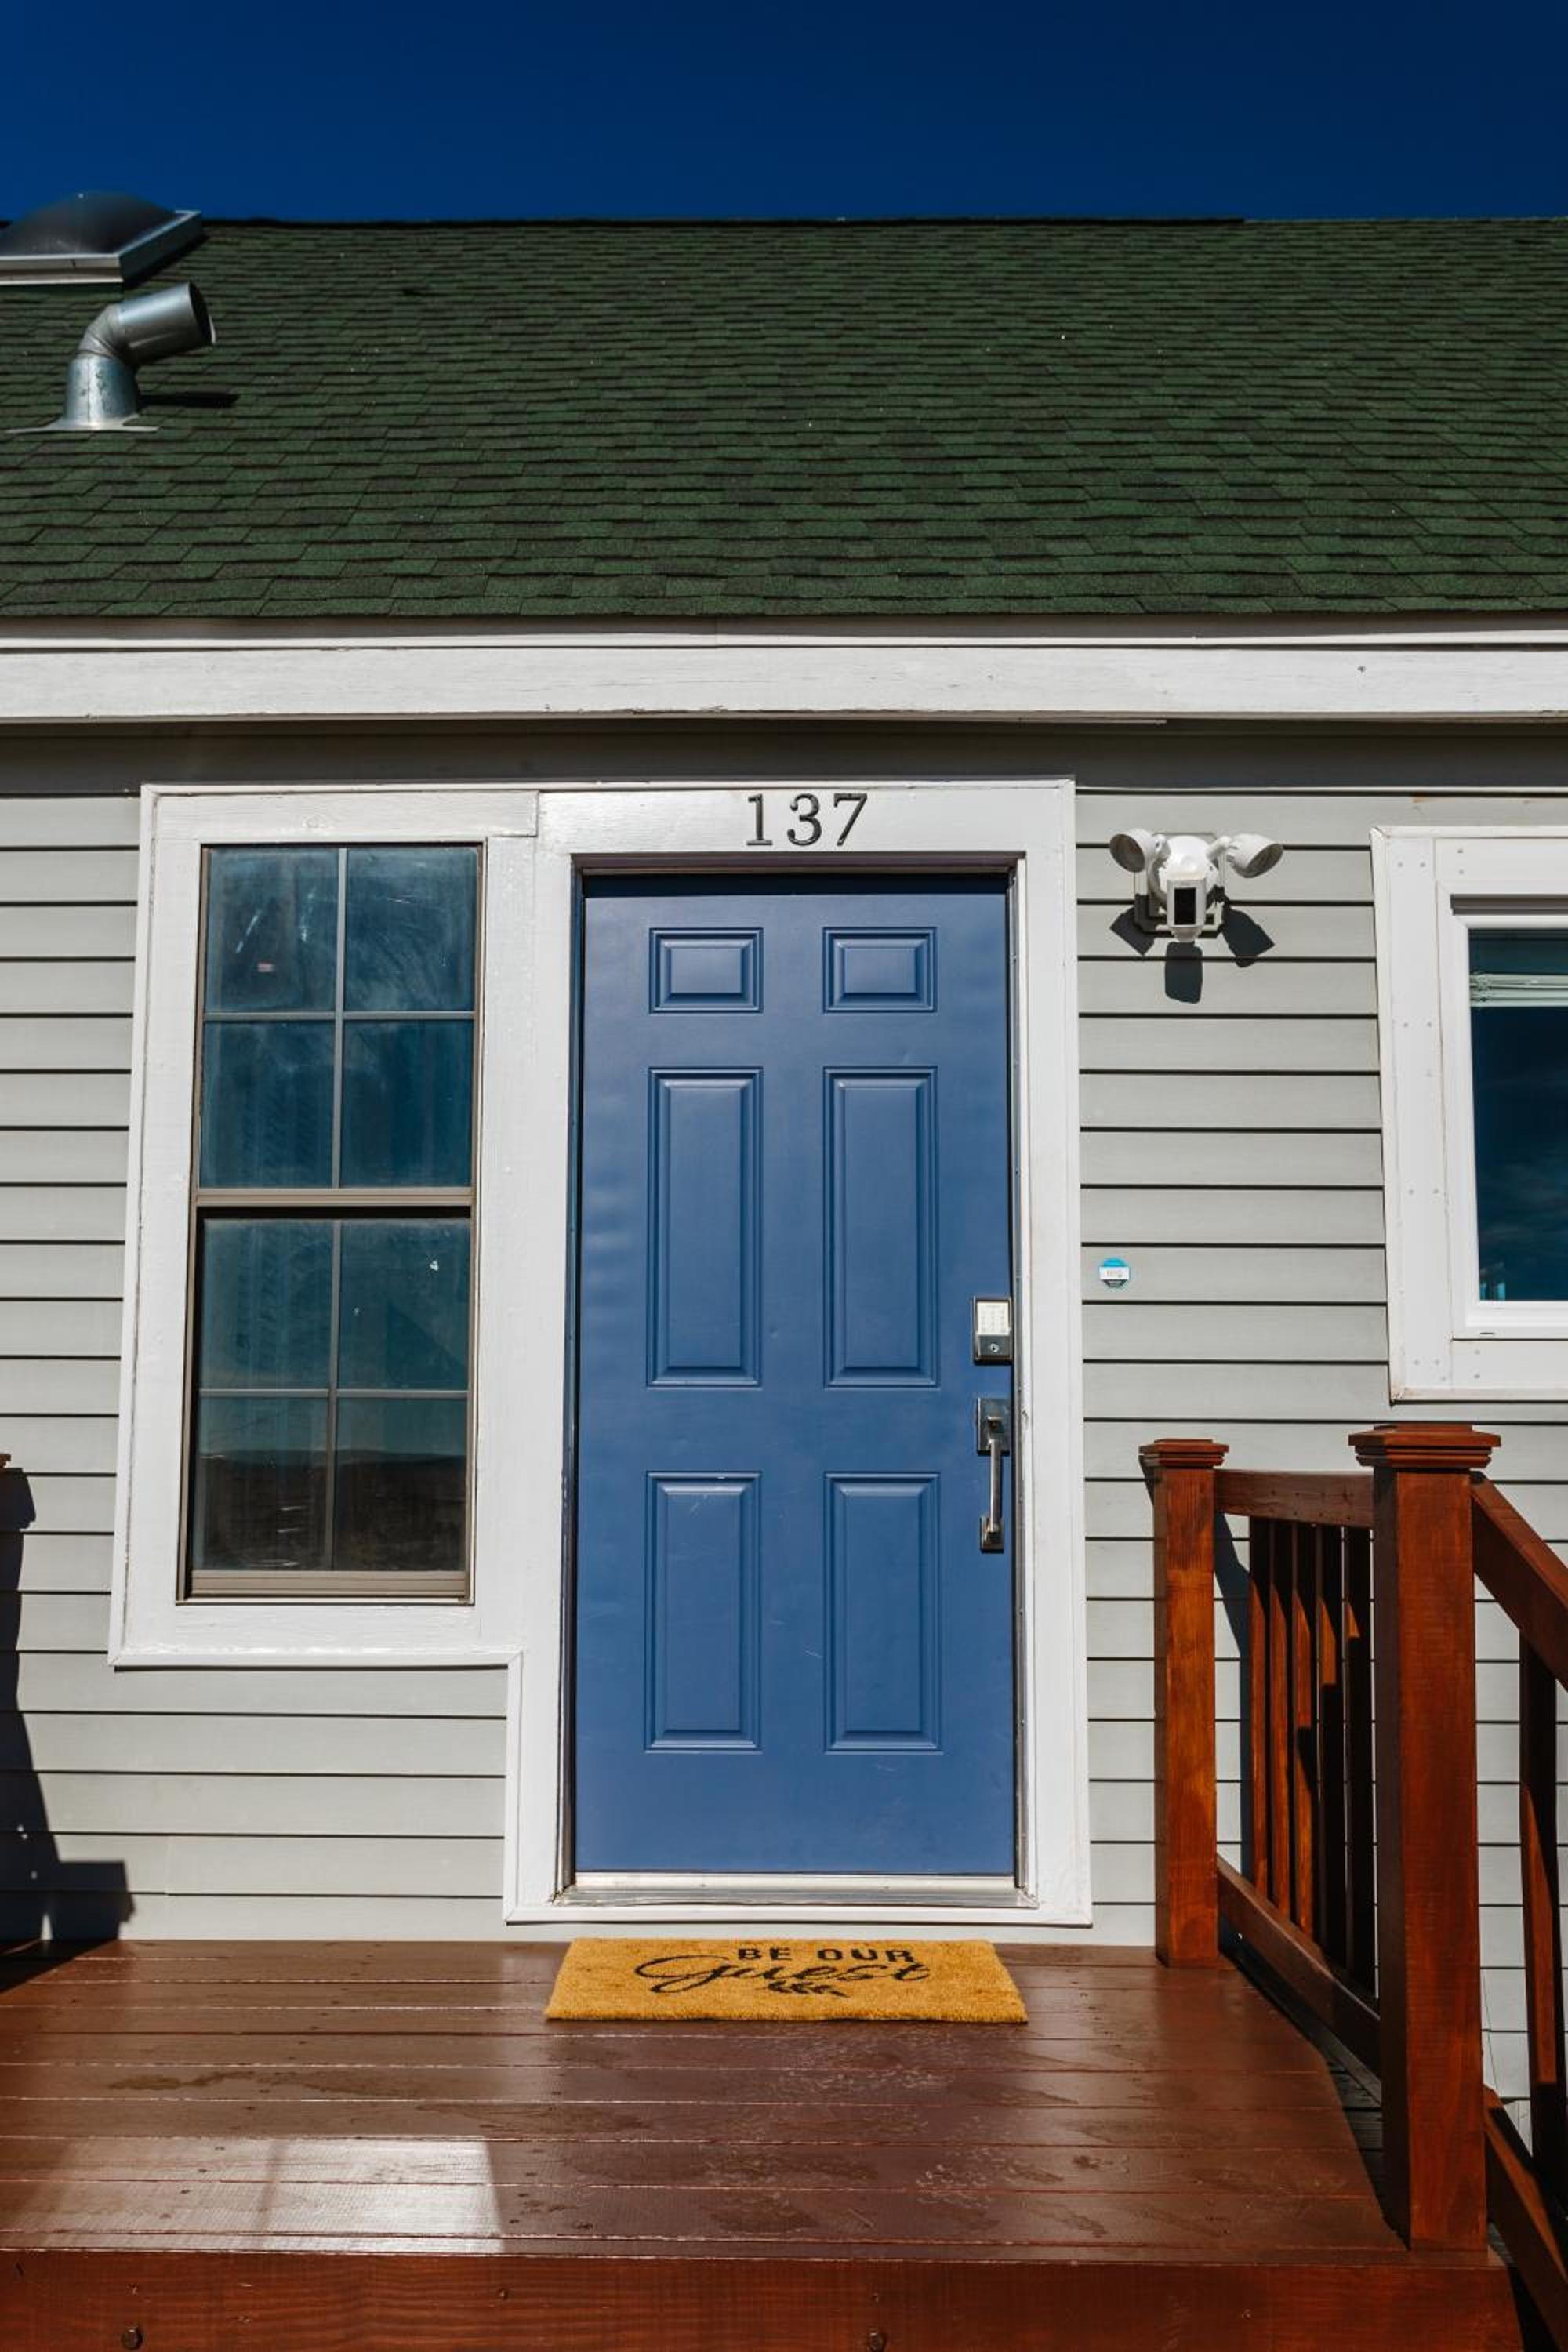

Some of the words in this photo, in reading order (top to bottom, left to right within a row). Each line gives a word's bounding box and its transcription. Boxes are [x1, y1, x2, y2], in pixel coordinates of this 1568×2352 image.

[746, 793, 868, 847] 137
[634, 1955, 931, 1994] Guest
[738, 1947, 792, 1961] BE
[817, 1947, 916, 1963] OUR
